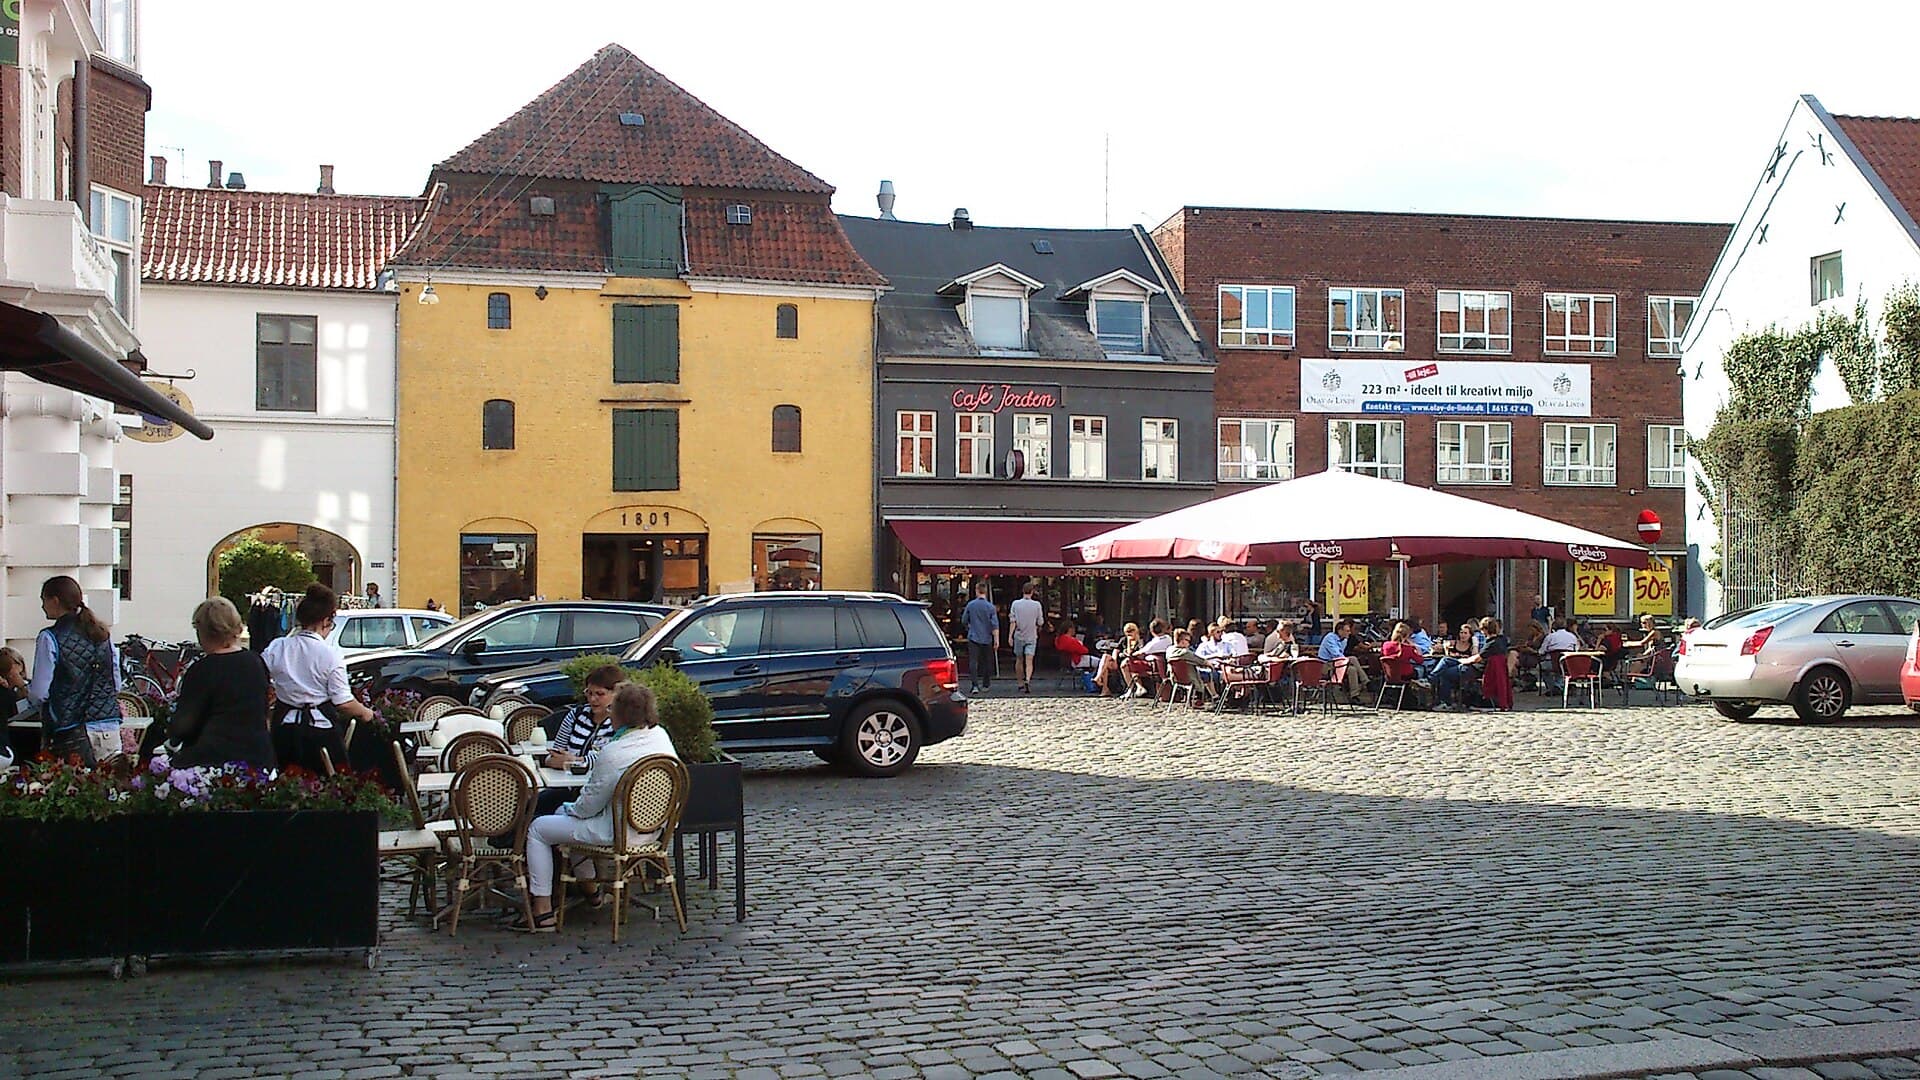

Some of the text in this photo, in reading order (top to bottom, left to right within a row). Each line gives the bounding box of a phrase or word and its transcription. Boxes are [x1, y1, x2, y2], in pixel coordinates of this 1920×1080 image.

[952, 384, 1057, 413] Café Jorden
[1361, 384, 1382, 395] 223
[1385, 384, 1401, 395] m²
[1410, 384, 1442, 396] ideelt
[1446, 385, 1457, 396] til
[1460, 385, 1503, 397] kreativt
[1300, 541, 1342, 560] Carlsberg
[1568, 544, 1607, 562] Carlsberg
[1064, 569, 1134, 577] JORDEN DREJER
[1580, 562, 1608, 572] SALE
[1577, 575, 1613, 600] 50%
[1634, 575, 1670, 600] 50%
